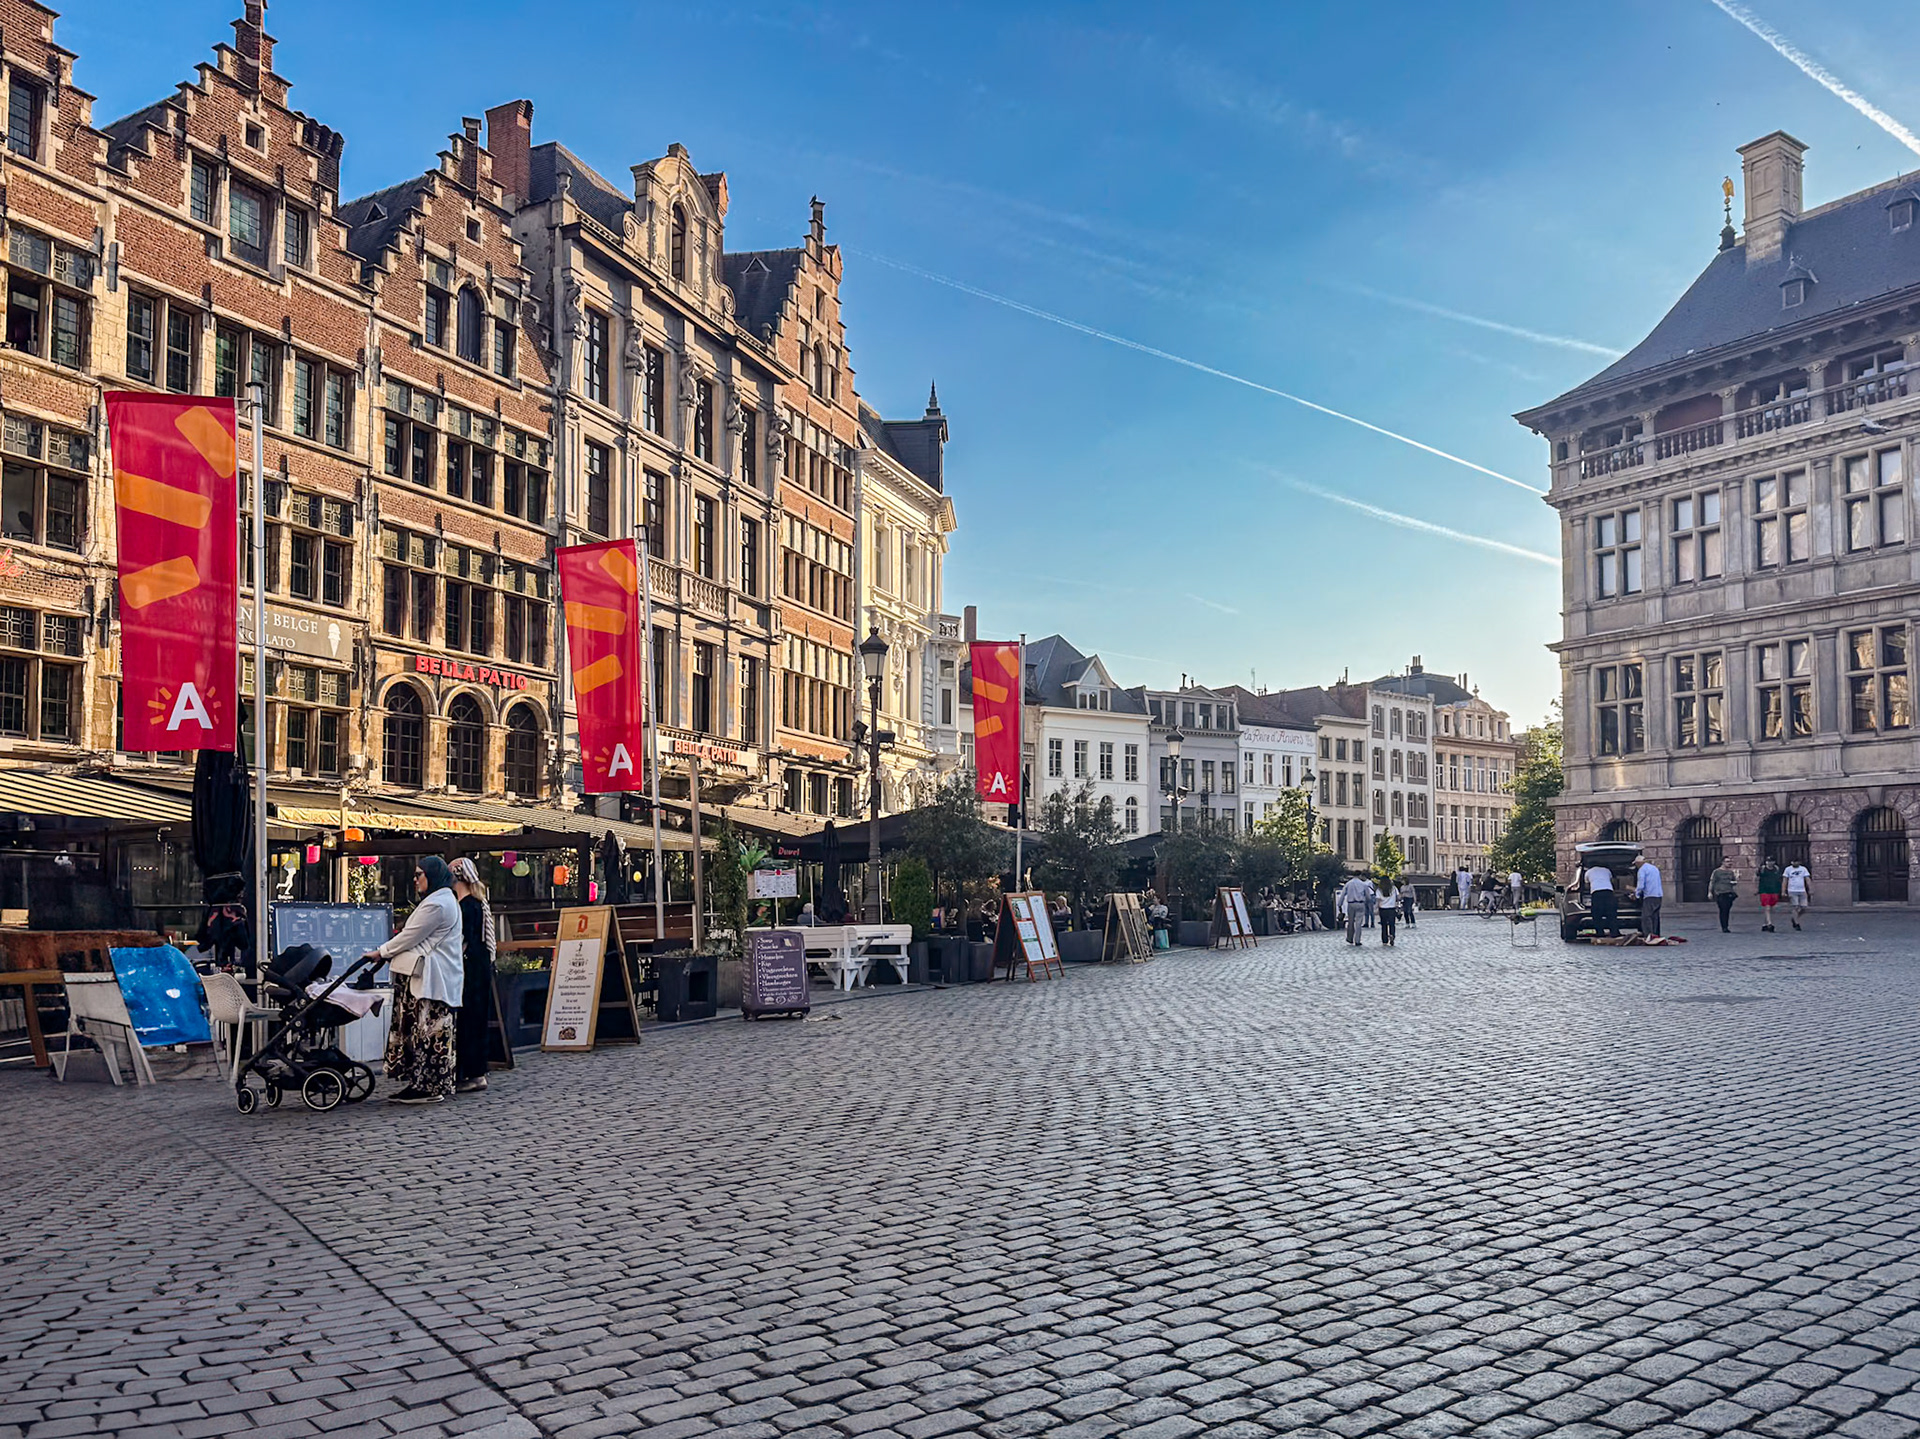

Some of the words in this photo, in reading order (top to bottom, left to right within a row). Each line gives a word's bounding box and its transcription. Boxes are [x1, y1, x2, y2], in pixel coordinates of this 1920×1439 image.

[273, 613, 318, 635] BELGE
[415, 655, 476, 682] BELLA
[478, 667, 528, 691] PATIO
[166, 682, 213, 731] A
[608, 743, 634, 778] A
[674, 740, 709, 760] BELLA
[711, 746, 738, 763] PATIO
[990, 771, 1007, 794] A
